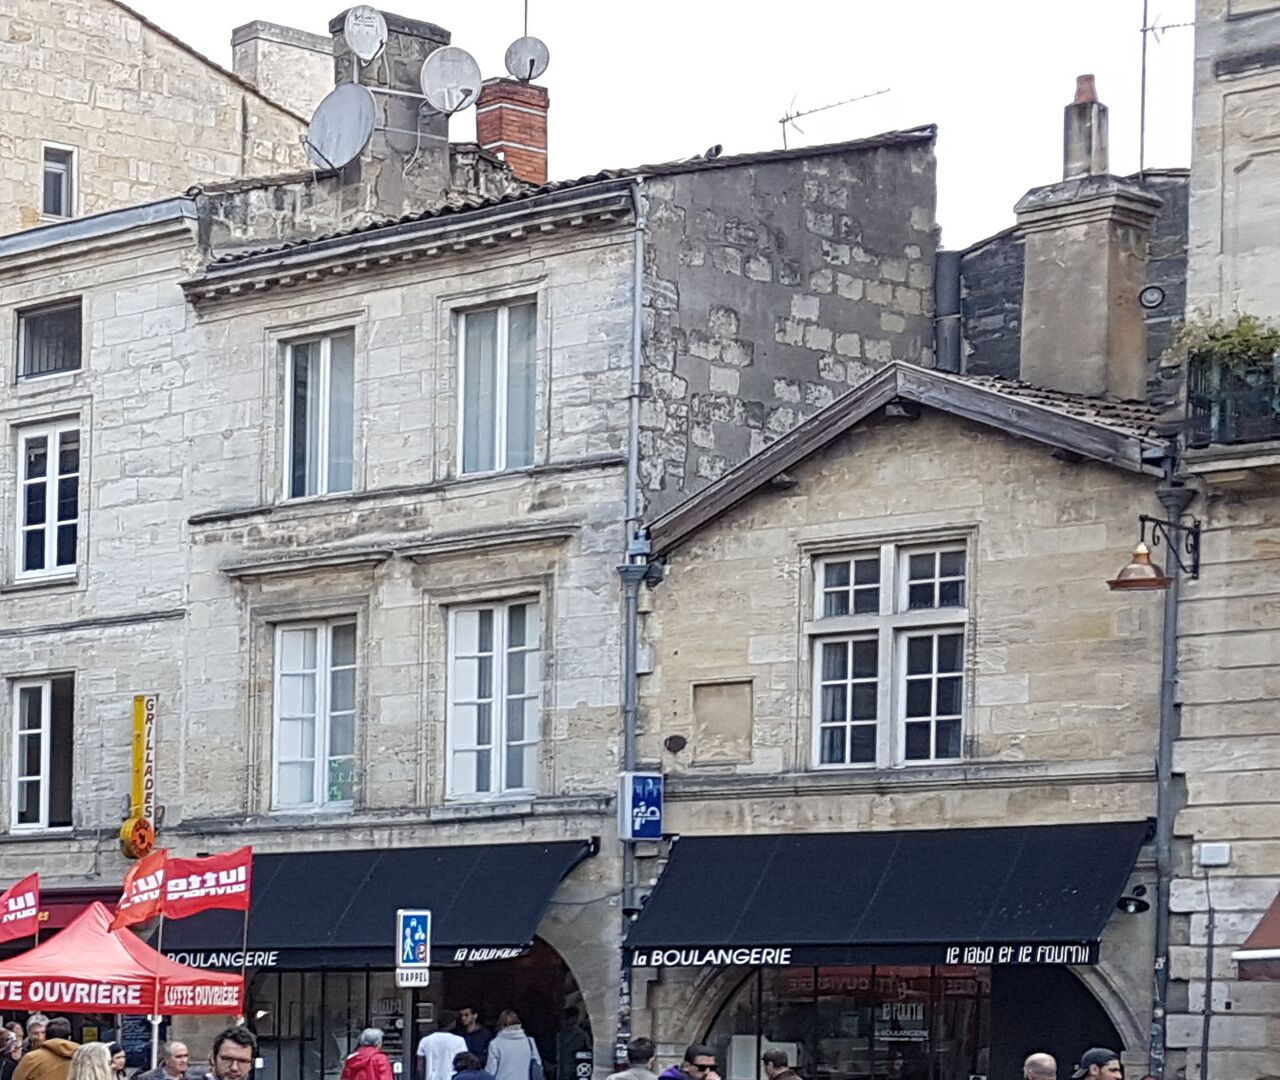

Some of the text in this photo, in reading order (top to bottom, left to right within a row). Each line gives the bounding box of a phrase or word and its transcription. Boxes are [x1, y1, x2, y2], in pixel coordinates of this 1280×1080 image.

[144, 698, 155, 818] GRILLADES
[632, 948, 792, 966] la BOULANGERIE
[945, 946, 960, 964] le
[963, 945, 994, 964] labo
[1018, 945, 1032, 963] le
[1036, 944, 1090, 964] fournil
[400, 971, 428, 983] RAPPEL
[28, 981, 141, 1005] OUVRIÈRE
[164, 985, 192, 1007] LUTTE
